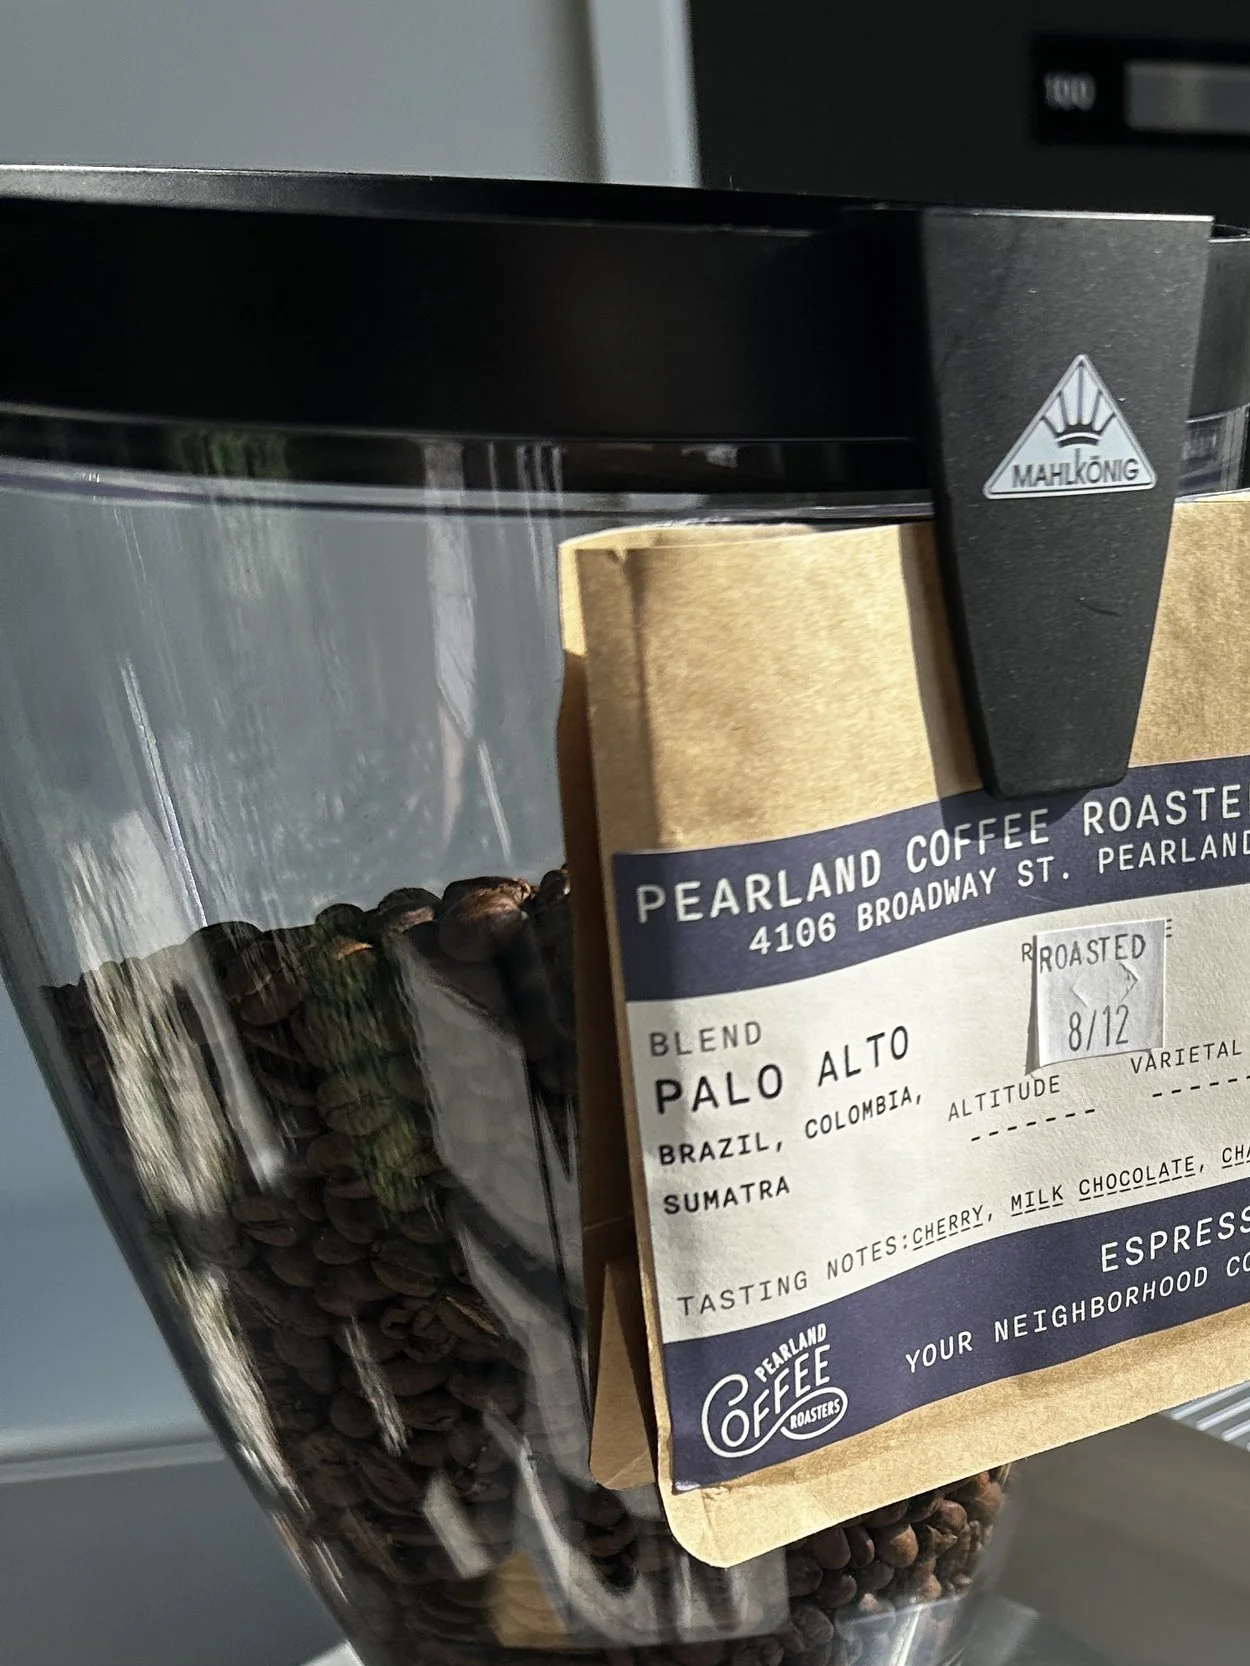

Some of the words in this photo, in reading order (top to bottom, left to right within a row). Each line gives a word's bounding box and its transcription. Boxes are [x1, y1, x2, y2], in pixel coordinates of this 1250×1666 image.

[636, 849, 881, 925] PEARLAND
[906, 809, 1049, 874] COFFEE
[749, 911, 837, 955] 4106
[857, 867, 997, 932] BROADWAY
[1017, 856, 1070, 887] ST.
[1039, 933, 1147, 974] ROASTED
[649, 1021, 763, 1057] BLEND
[1068, 1004, 1130, 1053] 8/12
[1131, 1039, 1243, 1074] VARIETAL
[654, 1064, 783, 1115] PALO
[816, 1025, 909, 1087] ALTO
[948, 1075, 1061, 1122] ALTITUDE
[659, 1132, 783, 1166] BRAZIL,
[805, 1086, 922, 1140] COLOMBIA,
[664, 1176, 791, 1215] SUMATRA
[677, 1270, 808, 1317] TASTING
[1010, 1184, 1064, 1213] MILK
[1078, 1155, 1206, 1198] CHOCOLATE,
[905, 1330, 974, 1374] YOUR
[994, 1266, 1209, 1343] NEIGHBORHOOD
[754, 1322, 827, 1383] PEARLAND
[701, 1344, 848, 1458] COFFEE
[790, 1398, 841, 1430] ROASTERS
